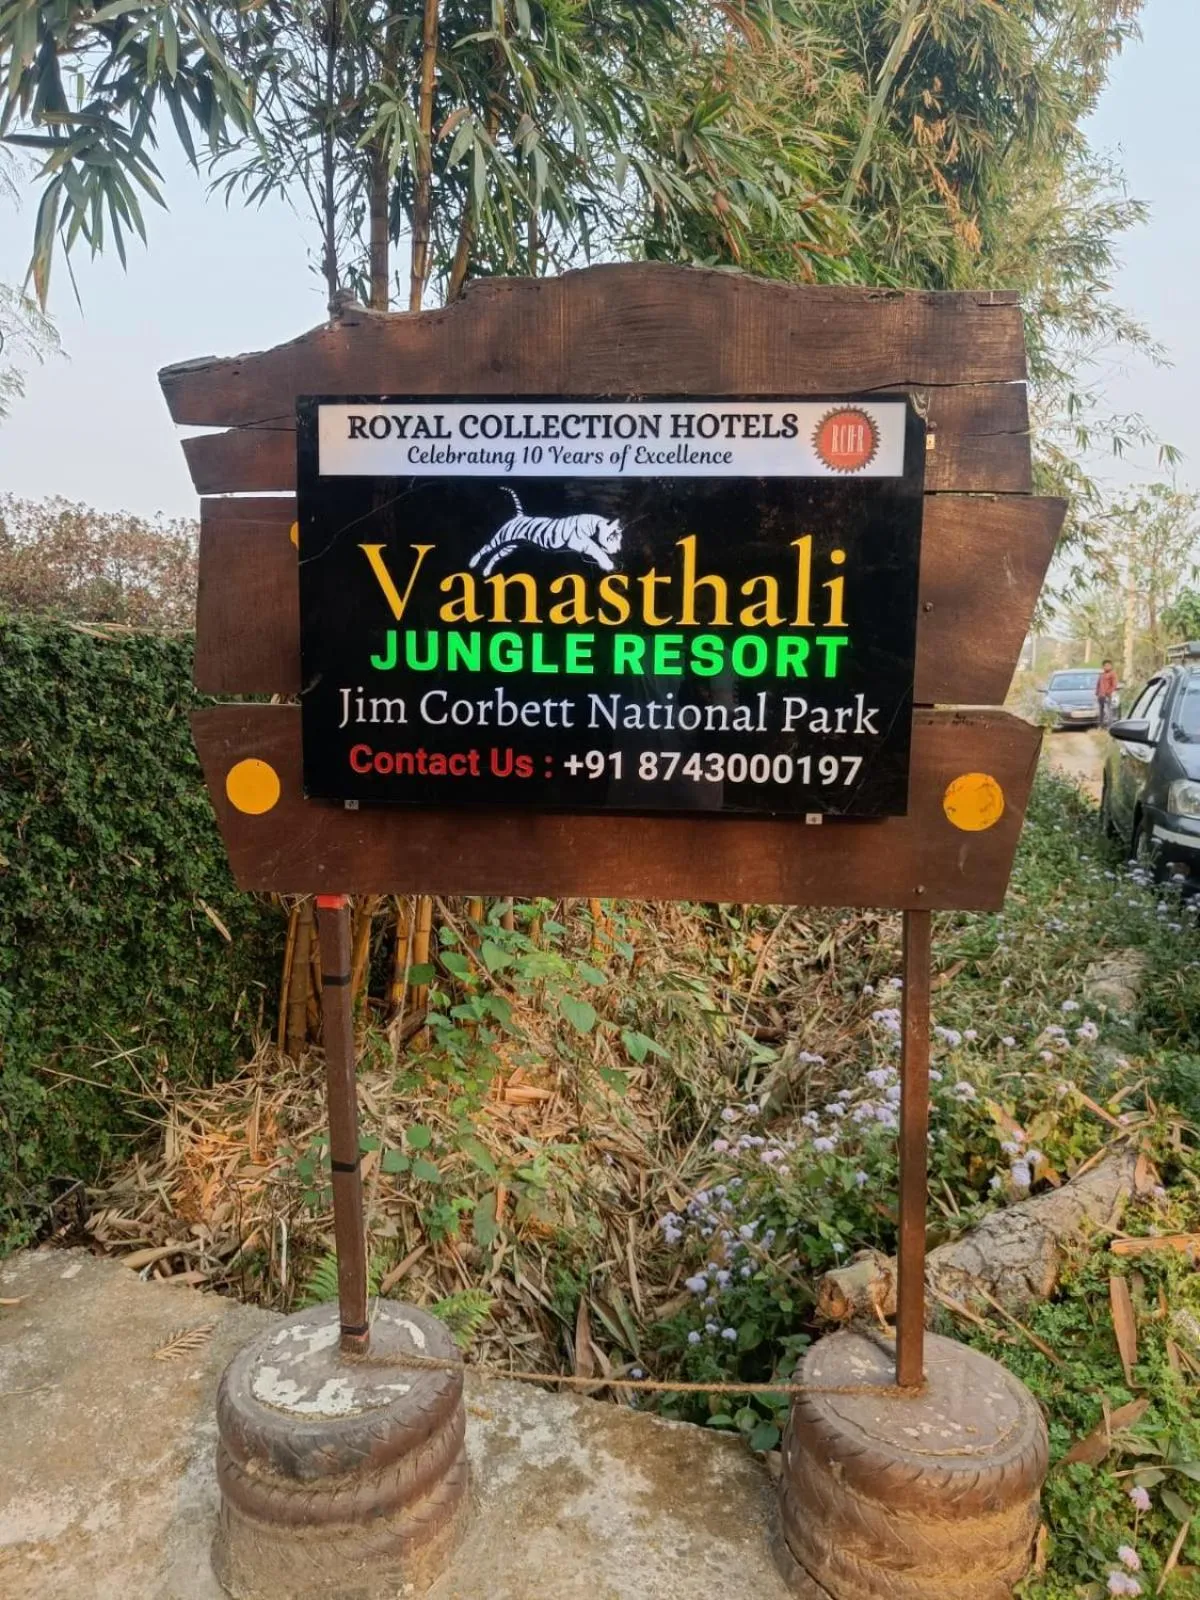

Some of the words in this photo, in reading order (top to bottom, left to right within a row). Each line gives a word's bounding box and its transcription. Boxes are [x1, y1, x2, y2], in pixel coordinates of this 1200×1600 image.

[348, 414, 451, 439] ROYAL
[459, 414, 662, 439] COLLECTION
[670, 413, 798, 438] HOTELS
[407, 445, 515, 471] Celebrating
[523, 446, 542, 464] 10
[549, 446, 603, 464] Years
[610, 444, 631, 472] of
[634, 444, 733, 464] Excellence
[358, 534, 849, 627] Vanasthali
[370, 630, 595, 674] JUNGLE
[613, 633, 849, 678] RESORT
[338, 686, 408, 728] Jim
[420, 687, 575, 728] Corbett
[587, 692, 767, 732] National
[781, 693, 880, 735] Park
[350, 744, 480, 777] Contact
[491, 747, 534, 778] Us
[564, 750, 623, 780] +91
[639, 751, 863, 786] 8743000197
